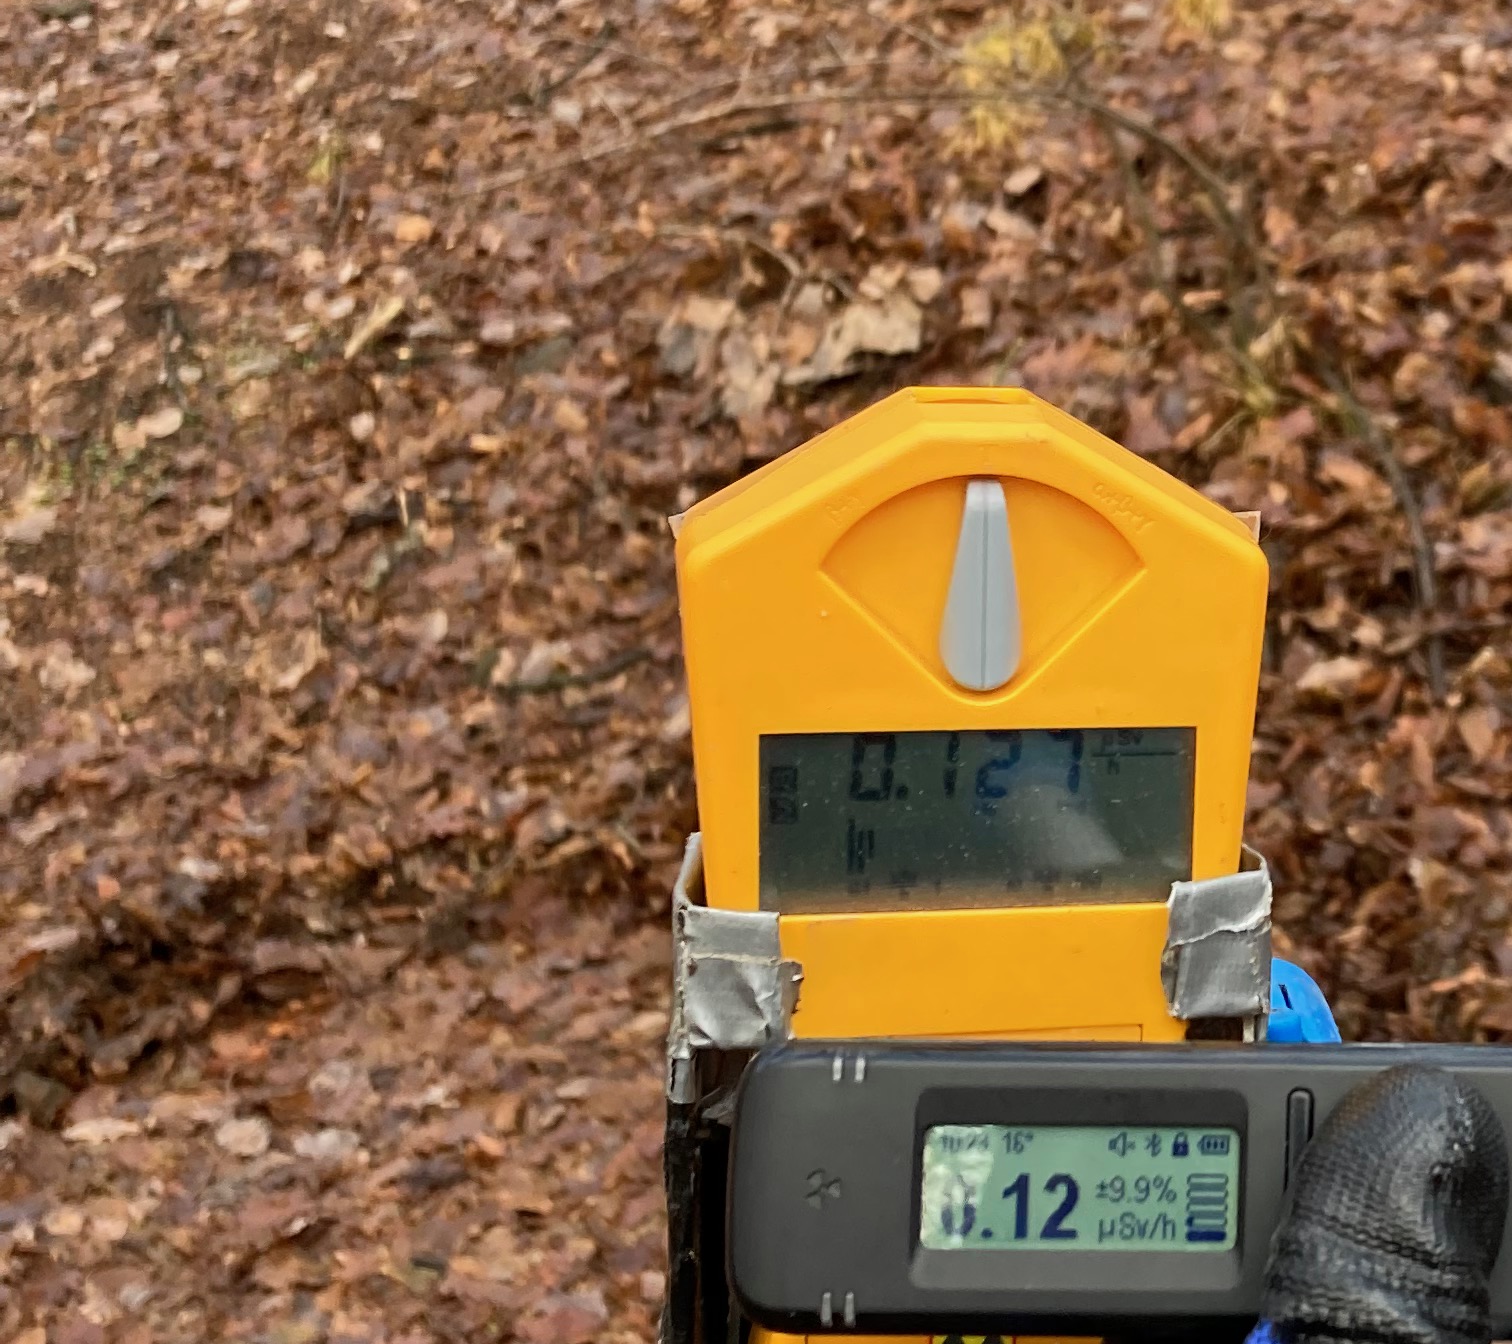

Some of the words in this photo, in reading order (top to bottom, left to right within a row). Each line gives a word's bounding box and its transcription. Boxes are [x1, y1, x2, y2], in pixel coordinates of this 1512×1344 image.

[1096, 1175, 1177, 1204] ±9.9%
[940, 1173, 1079, 1240] 0.12
[1098, 1213, 1176, 1243] µSv/h
